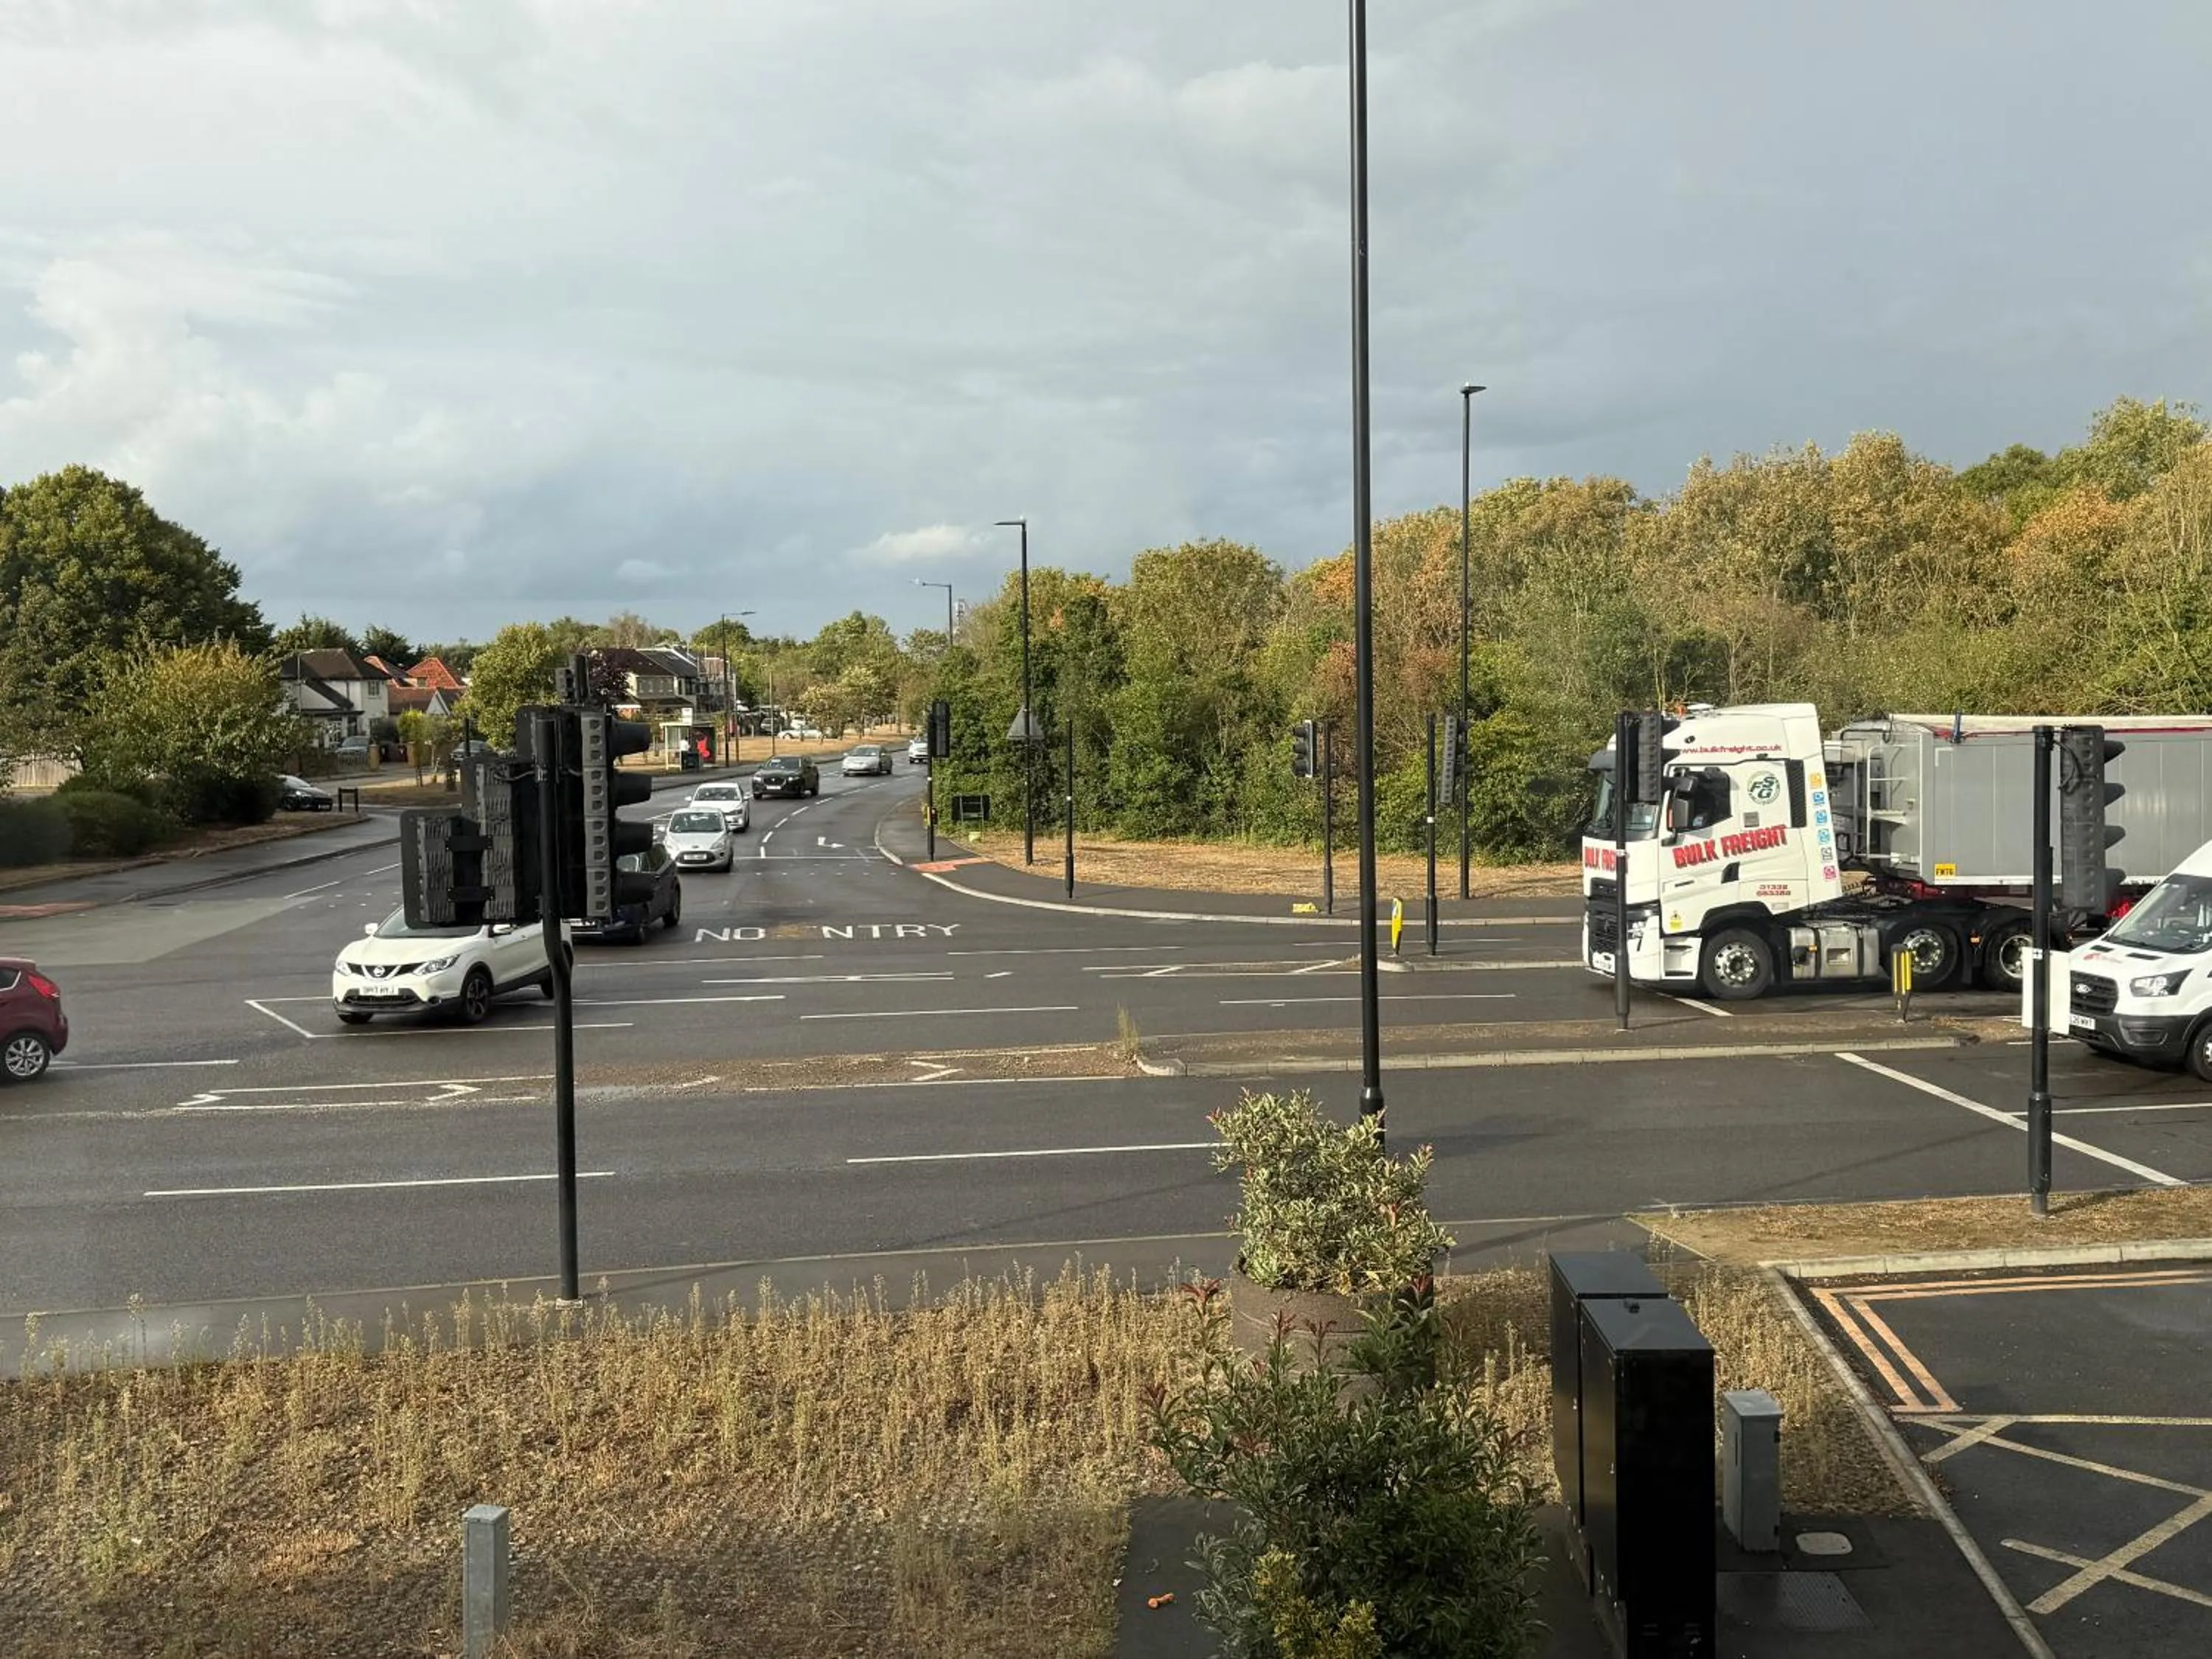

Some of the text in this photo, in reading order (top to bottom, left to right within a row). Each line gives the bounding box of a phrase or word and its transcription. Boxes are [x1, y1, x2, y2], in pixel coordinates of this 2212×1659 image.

[1672, 824, 1788, 869] BULK FREIGHT
[694, 923, 961, 942] NO NTRY
